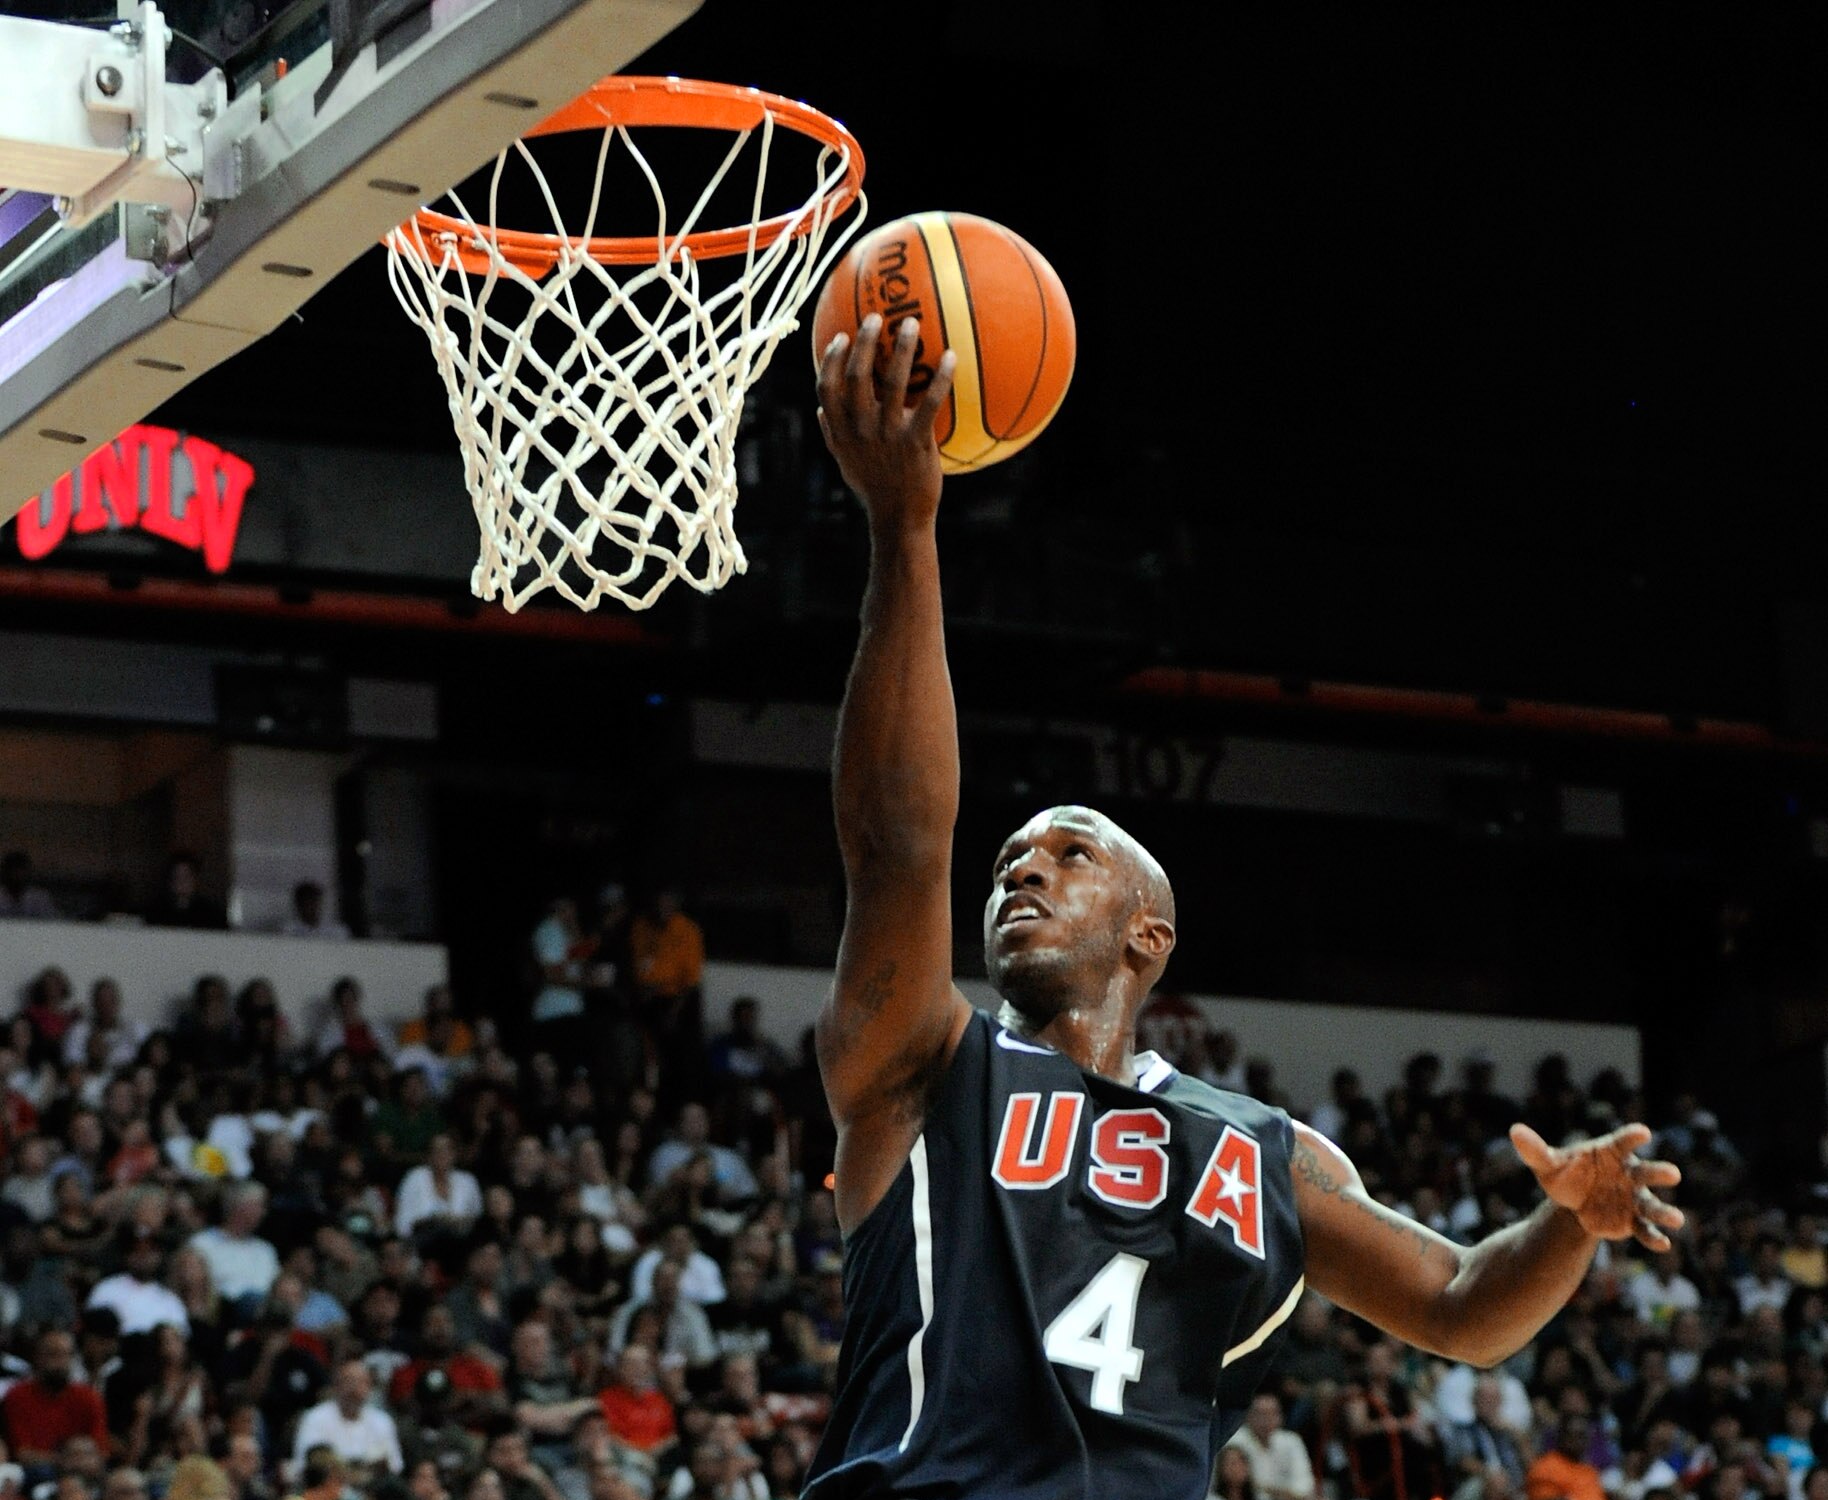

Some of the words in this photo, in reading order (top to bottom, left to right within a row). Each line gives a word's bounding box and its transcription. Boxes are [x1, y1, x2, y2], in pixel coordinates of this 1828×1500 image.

[17, 424, 255, 573] UNLV
[1108, 737, 1223, 801] 107
[991, 1091, 1266, 1260] USA
[1043, 1251, 1149, 1415] 4
